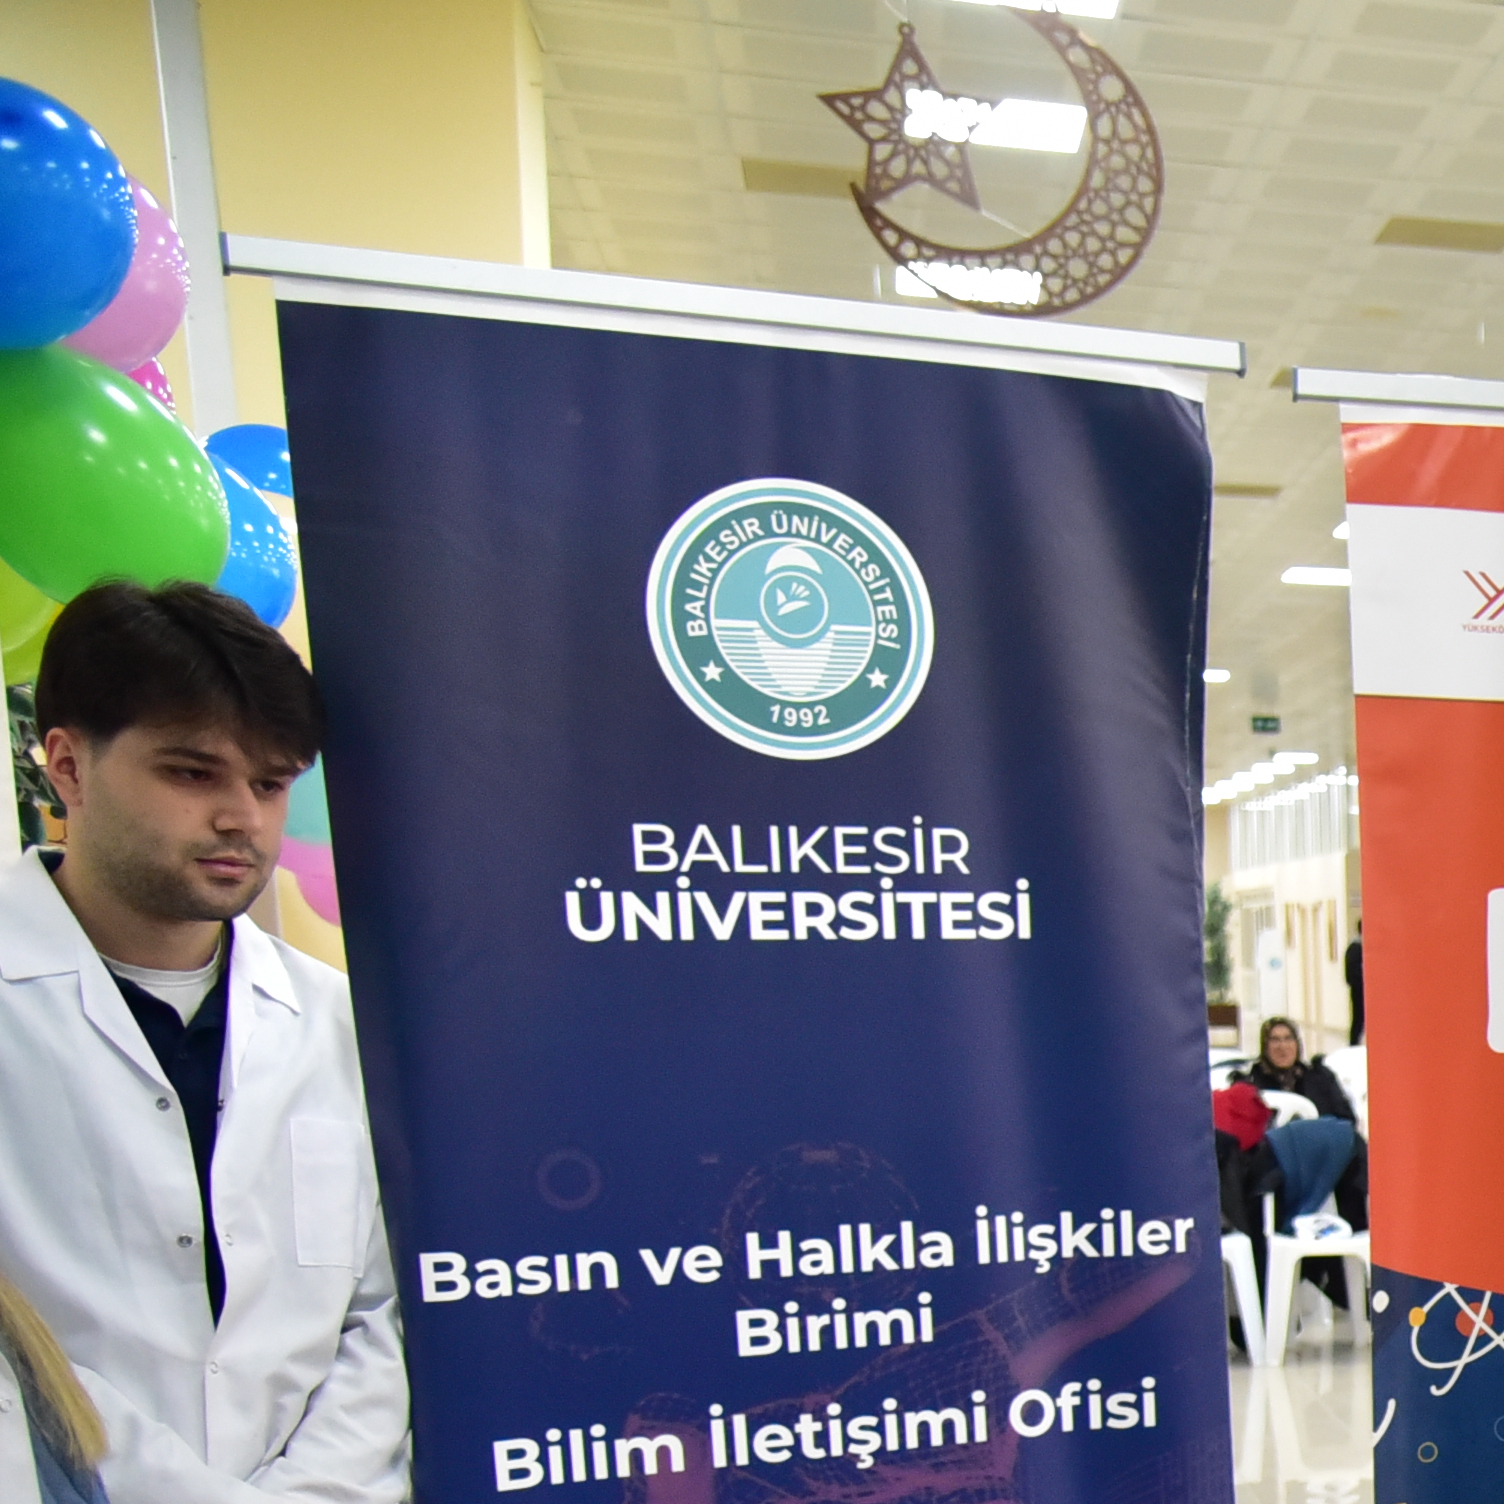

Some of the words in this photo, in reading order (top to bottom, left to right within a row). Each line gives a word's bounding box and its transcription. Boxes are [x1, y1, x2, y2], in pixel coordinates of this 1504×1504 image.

[684, 517, 765, 637] BALIKESİR
[770, 509, 901, 649] ÜNİVERSİTESİ
[769, 703, 831, 728] 1992
[632, 815, 970, 875] BALIKESİR
[565, 876, 1032, 943] ÜNİVERSİTESİ
[418, 1248, 619, 1303] Basın
[641, 1240, 723, 1286] ve
[745, 1220, 954, 1281] Halkla
[975, 1204, 1196, 1275] İlişkiler
[735, 1291, 936, 1358] Birimi
[492, 1422, 685, 1493] Bilim
[709, 1389, 989, 1470] İletişimi
[1008, 1377, 1159, 1439] Ofisi
